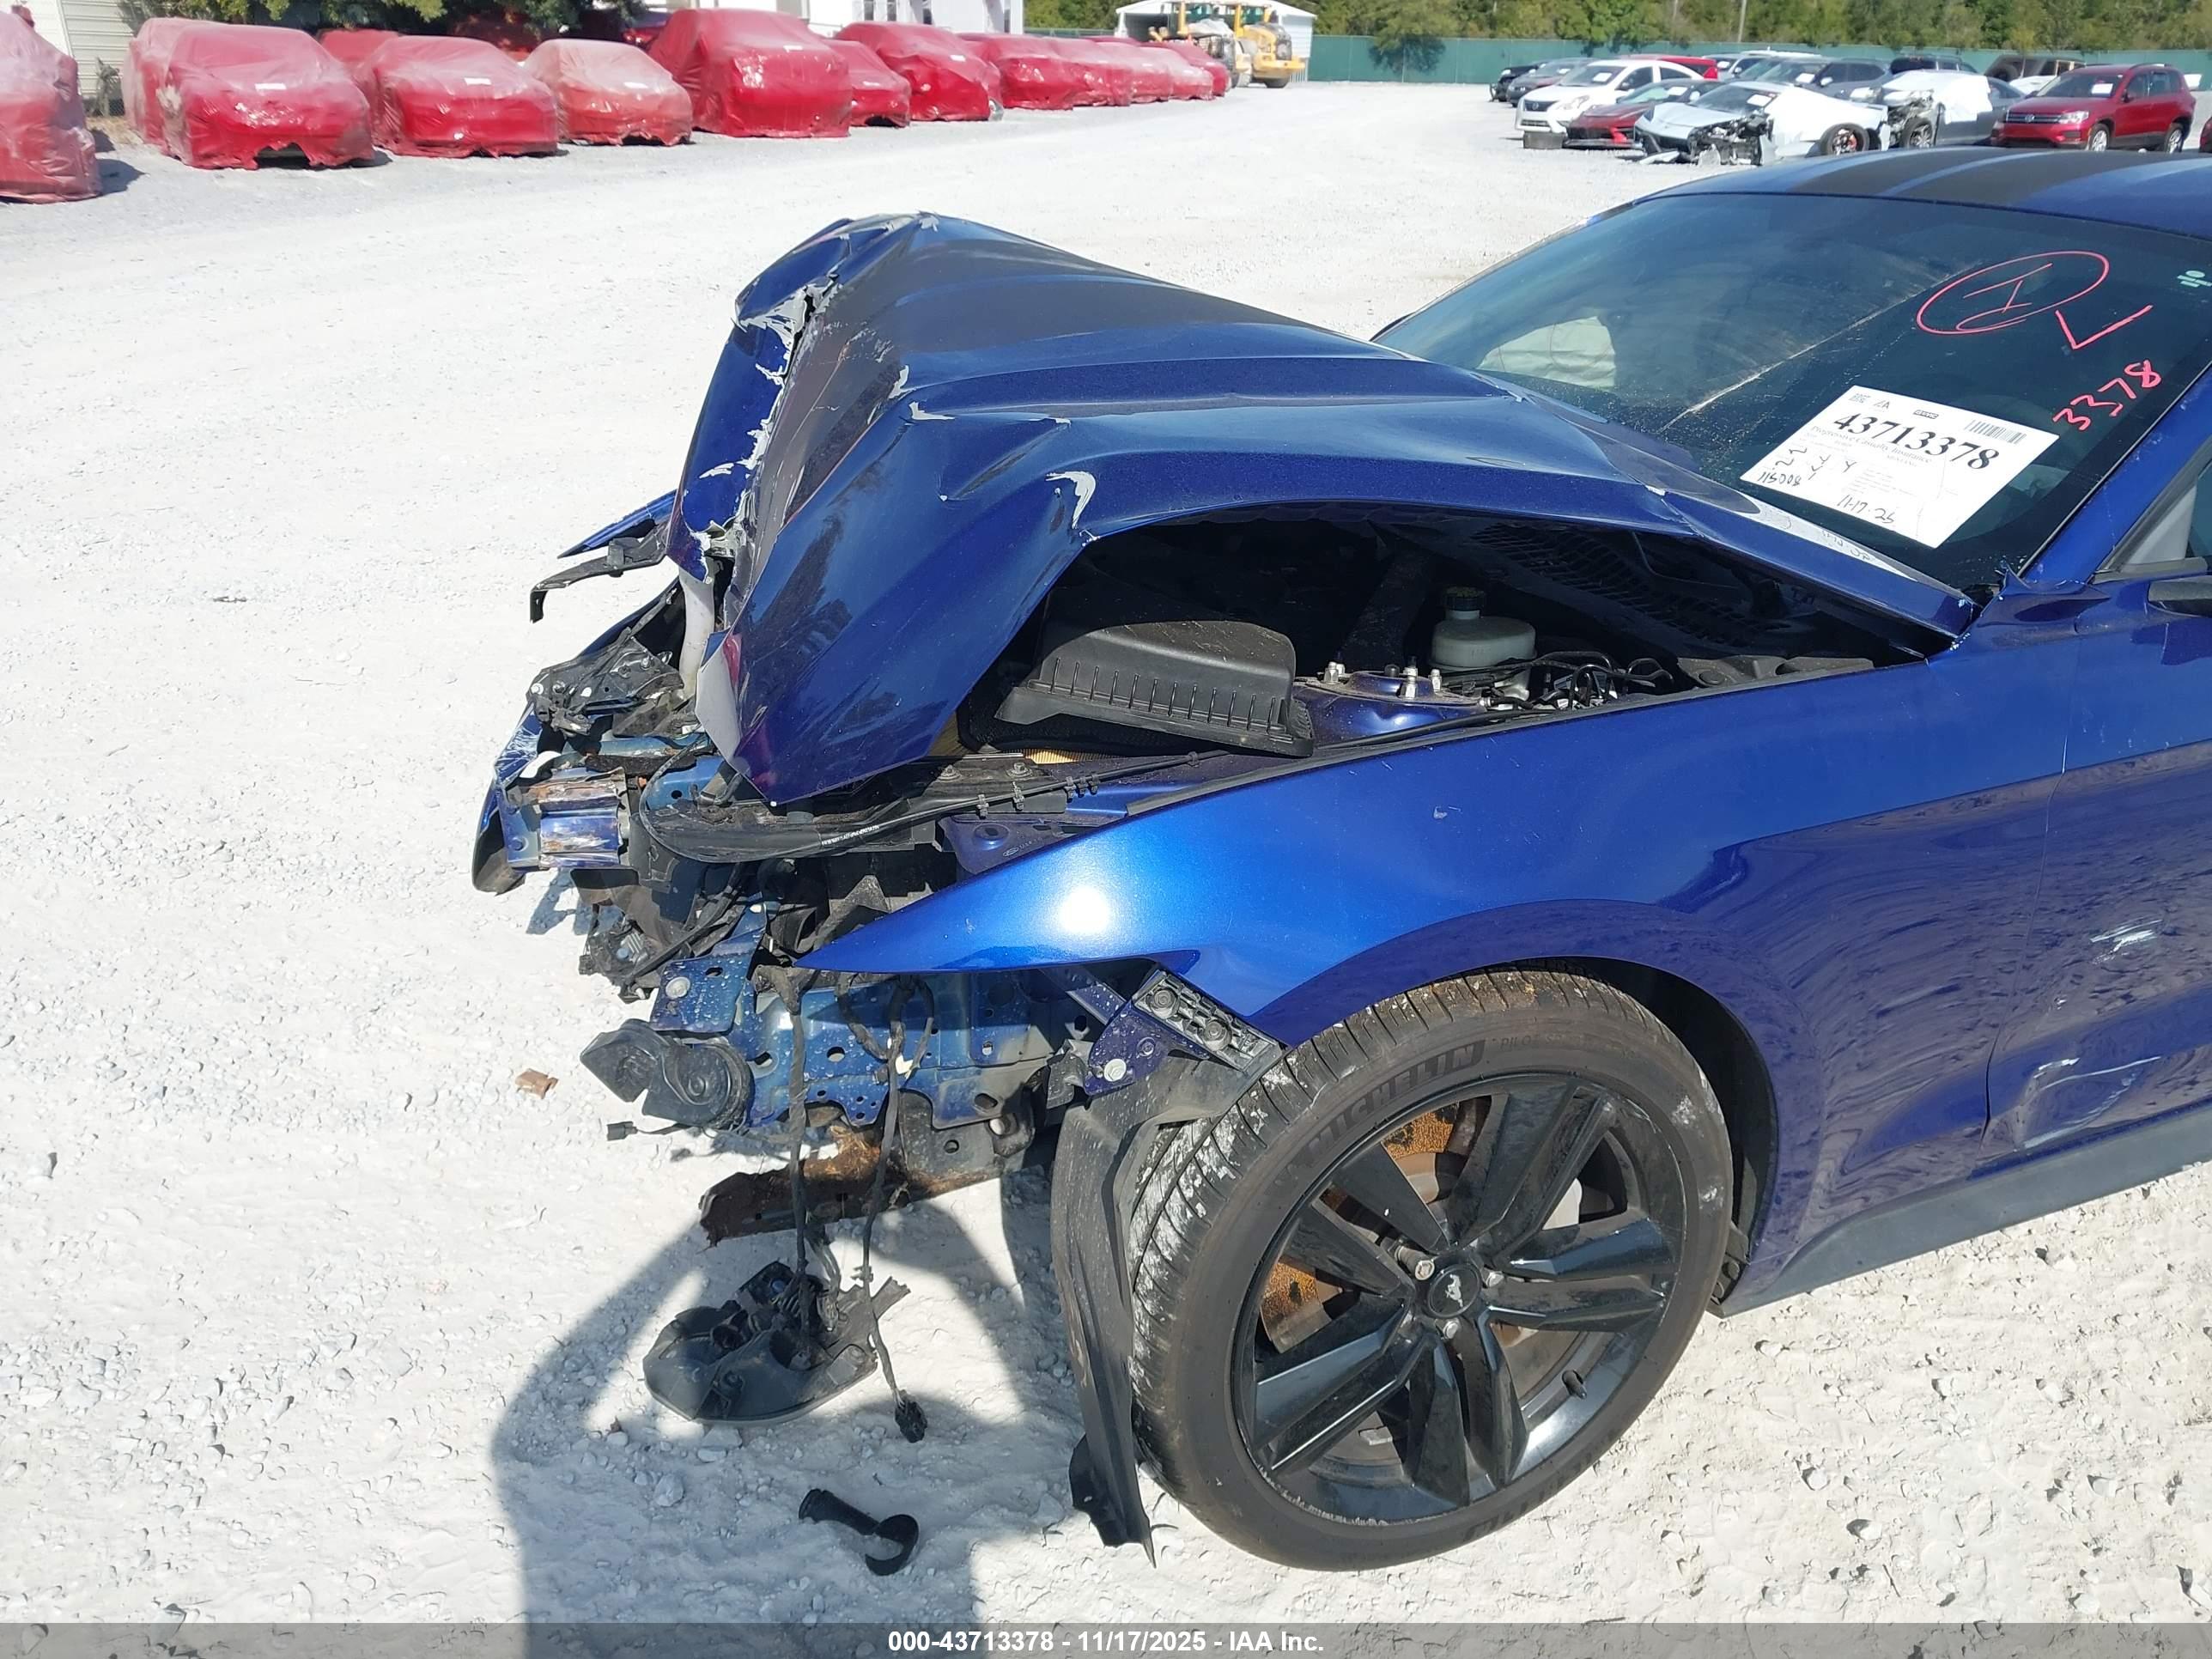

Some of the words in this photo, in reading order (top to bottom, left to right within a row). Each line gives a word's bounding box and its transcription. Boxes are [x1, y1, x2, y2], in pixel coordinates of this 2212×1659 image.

[2051, 359, 2162, 430] 3378
[1833, 412, 2000, 471] 43713378
[1305, 1043, 1476, 1156] MICHELIN
